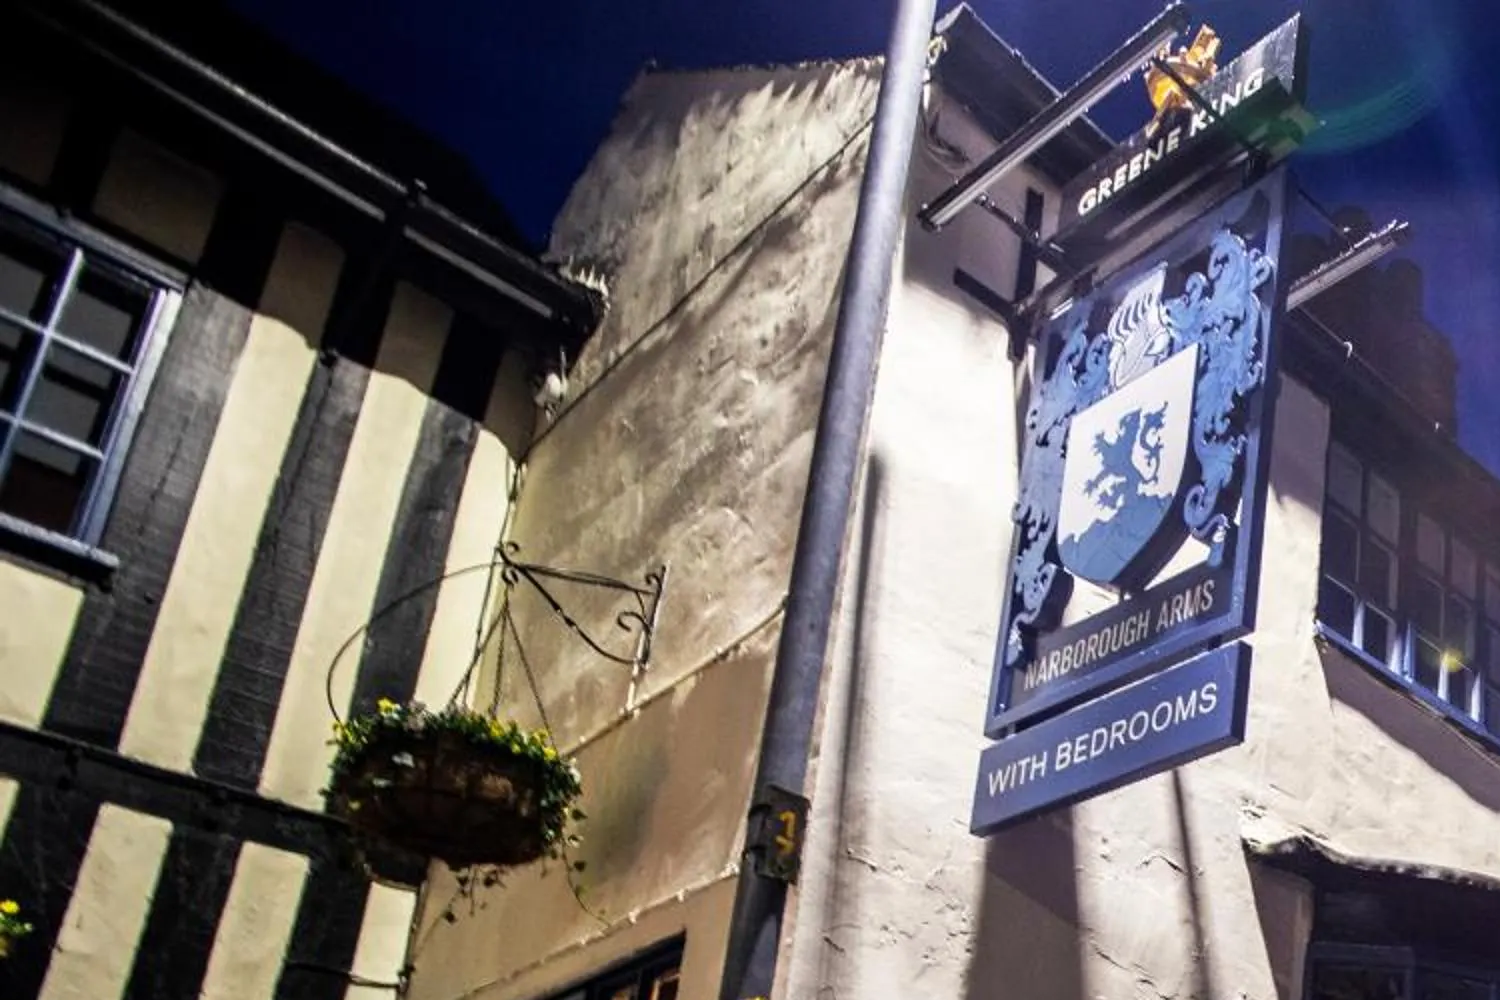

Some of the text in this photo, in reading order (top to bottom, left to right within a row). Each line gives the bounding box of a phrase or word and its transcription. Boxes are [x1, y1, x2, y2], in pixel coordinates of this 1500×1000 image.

[1078, 67, 1264, 216] GREENE KING
[1023, 579, 1216, 691] NARBOROUGH ARMS
[987, 682, 1218, 797] WITH BEDROOMS
